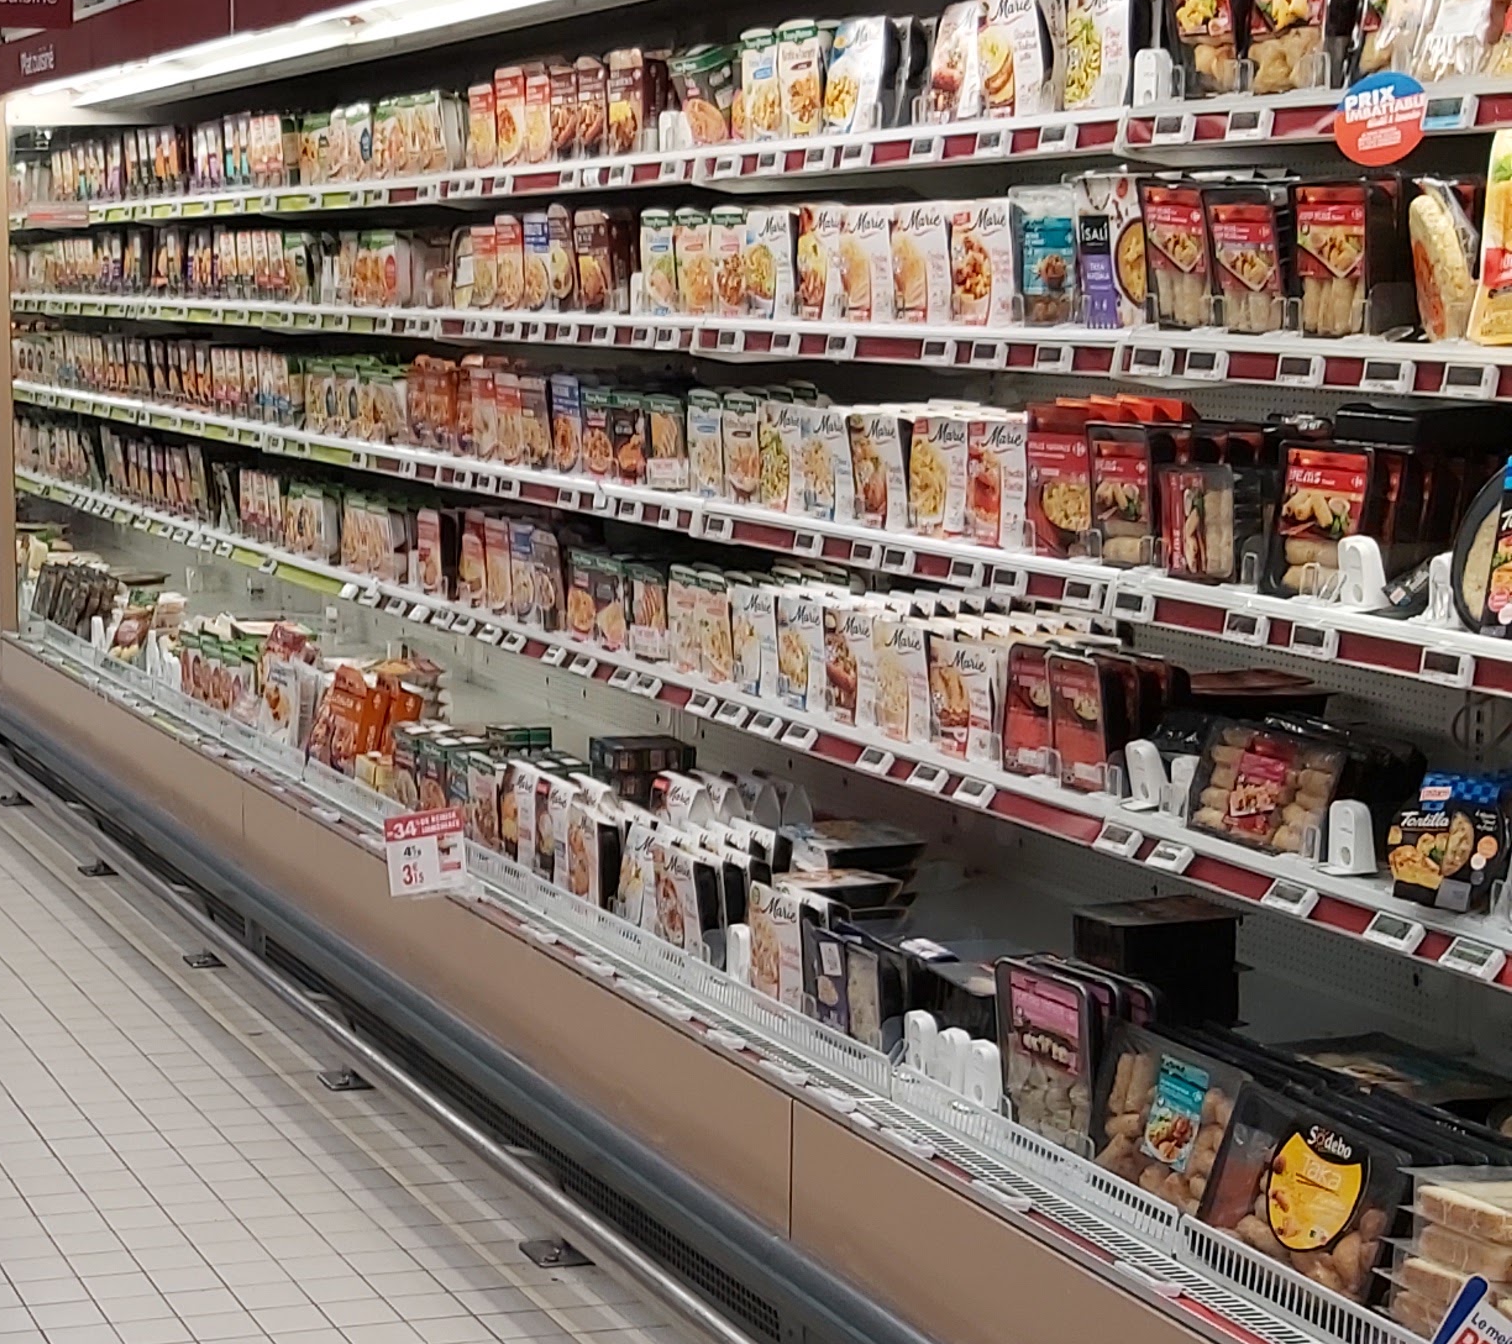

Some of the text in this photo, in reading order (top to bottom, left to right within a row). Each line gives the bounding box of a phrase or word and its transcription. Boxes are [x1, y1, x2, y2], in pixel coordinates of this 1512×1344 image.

[1345, 85, 1395, 111] PRIX
[849, 212, 884, 233] Marie
[903, 209, 941, 231] Marie
[968, 207, 1006, 230] Marie
[928, 423, 966, 444] Marie
[982, 425, 1024, 447] Marie
[789, 605, 820, 626] Marie
[839, 616, 870, 638] Marie
[884, 629, 922, 651] Marie
[948, 650, 986, 673] Marie
[1400, 811, 1450, 828] Tortilla
[762, 897, 797, 924] Marie
[1471, 1312, 1487, 1330] Le
